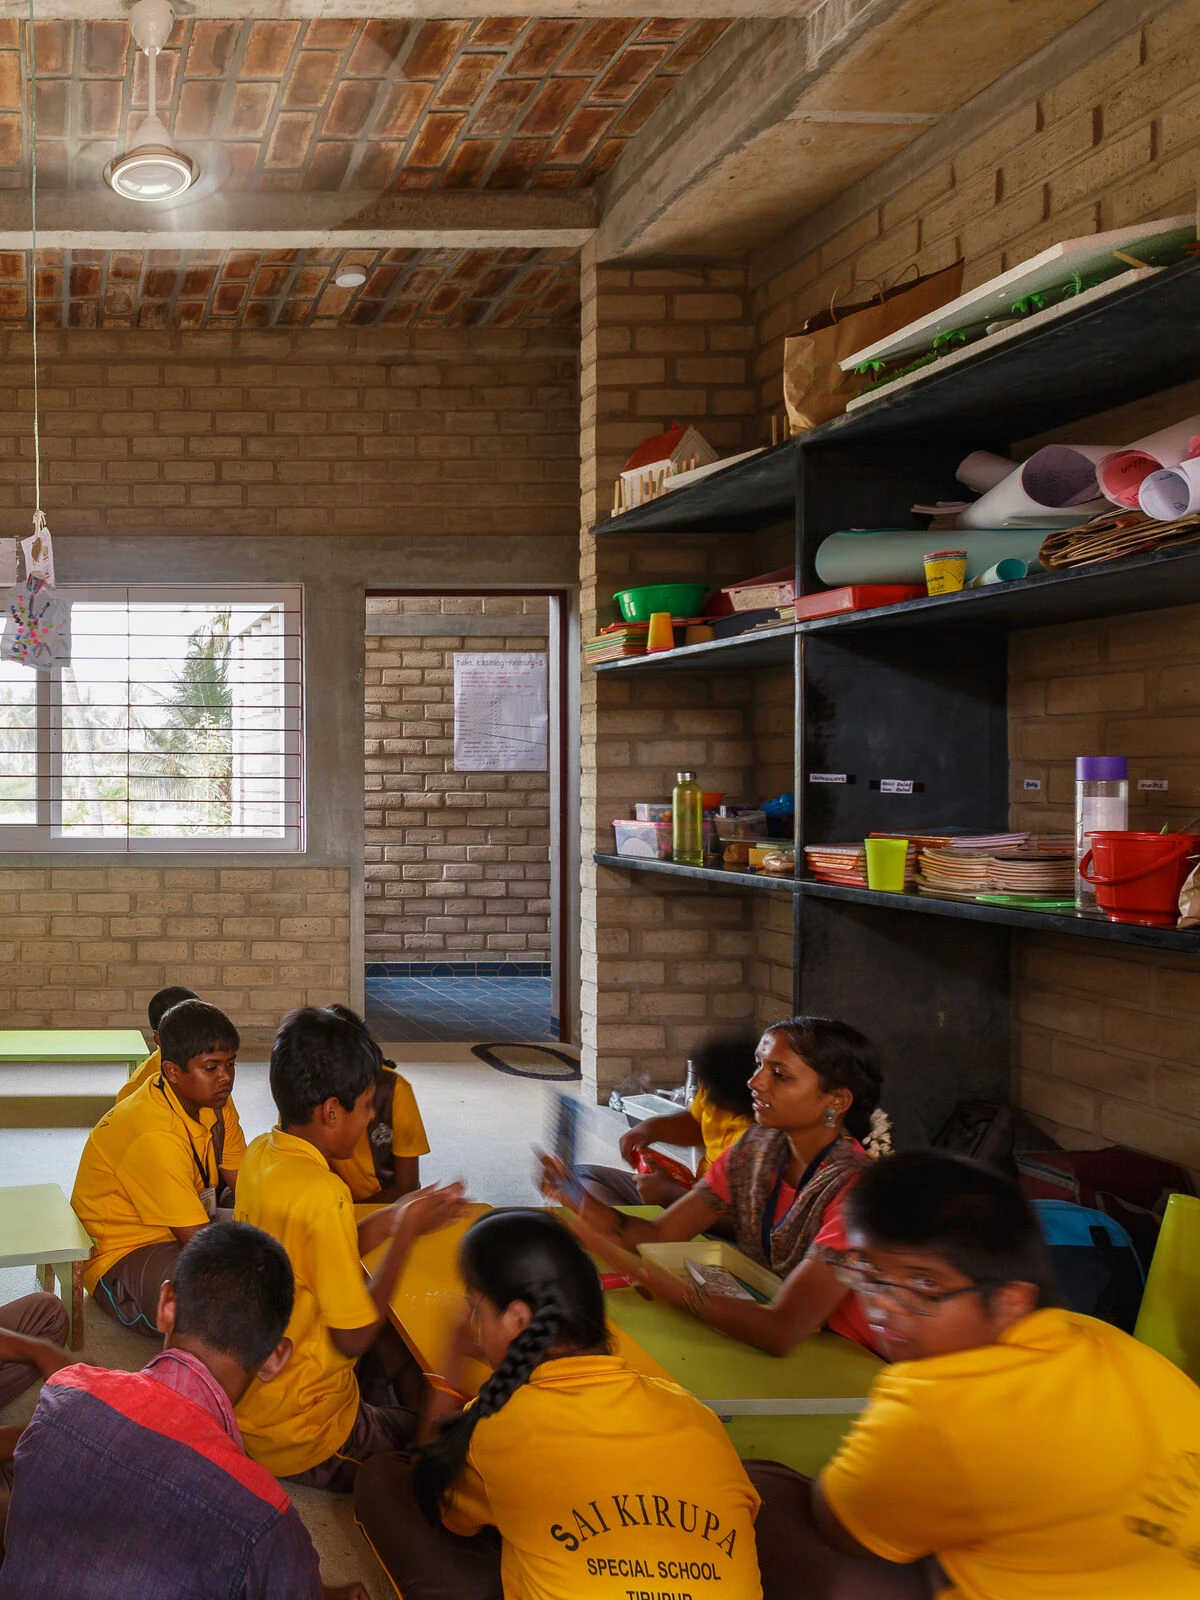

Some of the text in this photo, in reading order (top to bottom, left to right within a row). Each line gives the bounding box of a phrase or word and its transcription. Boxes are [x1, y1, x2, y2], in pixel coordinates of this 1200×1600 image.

[550, 1494, 738, 1559] SAI KIRUPA
[586, 1558, 721, 1581] SPECIAL SCHOOL
